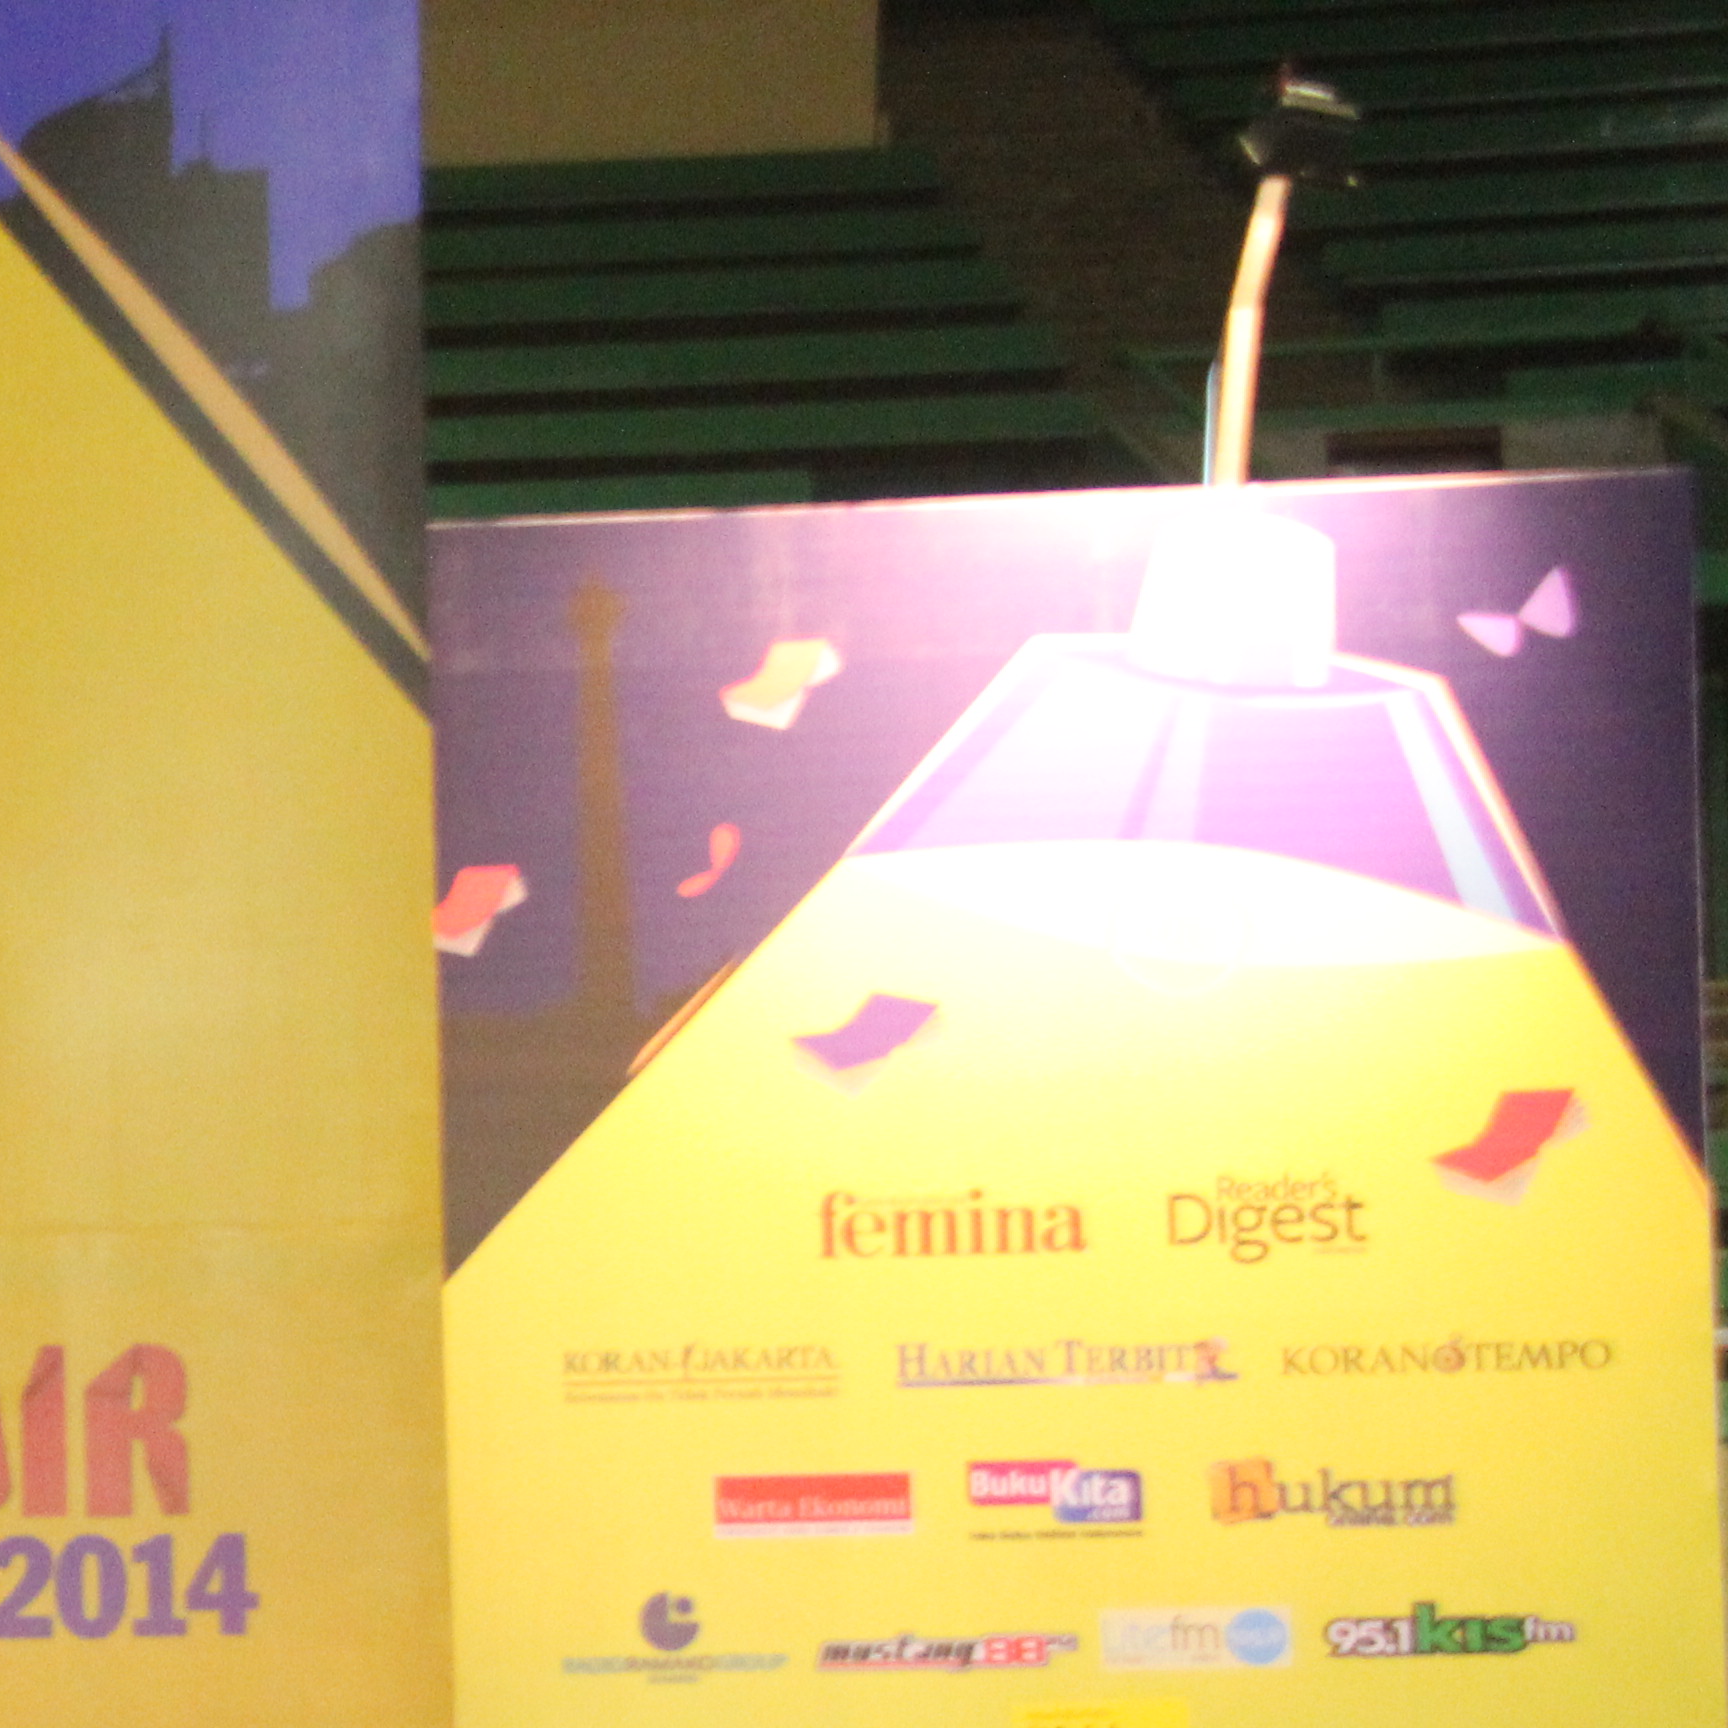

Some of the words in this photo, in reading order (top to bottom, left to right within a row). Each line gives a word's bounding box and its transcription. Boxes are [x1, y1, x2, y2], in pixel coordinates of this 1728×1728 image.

[1216, 1174, 1338, 1201] Reader's
[818, 1189, 1087, 1259] femina
[1167, 1193, 1367, 1264] Digest
[1281, 1346, 1428, 1375] KORAN
[1464, 1339, 1610, 1371] TEMPO
